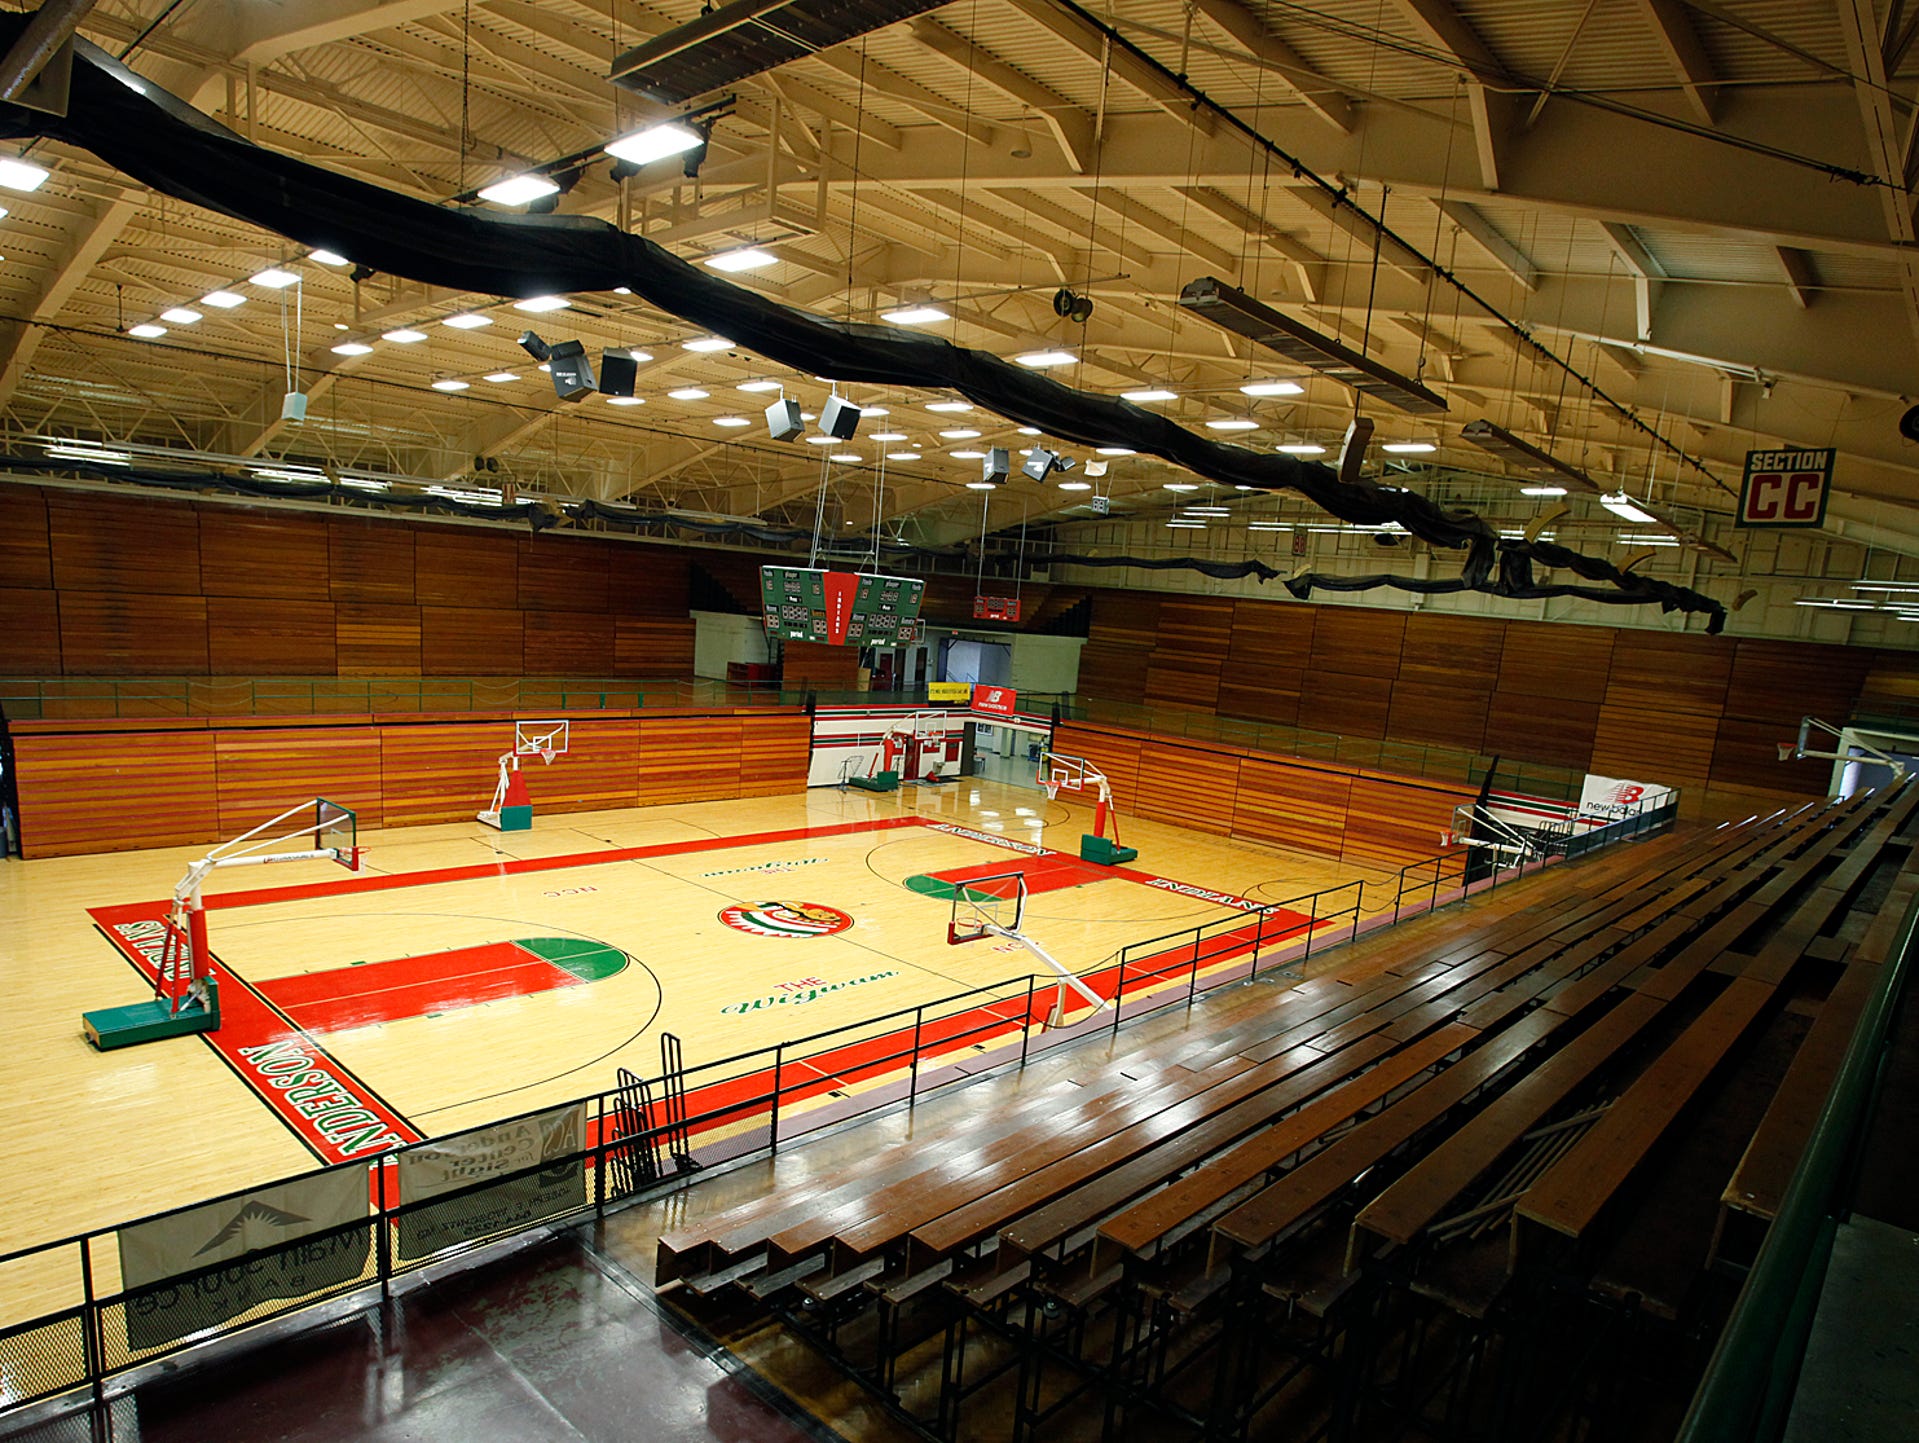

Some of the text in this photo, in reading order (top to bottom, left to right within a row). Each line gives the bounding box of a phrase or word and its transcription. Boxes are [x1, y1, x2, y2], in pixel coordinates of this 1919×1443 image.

[1750, 451, 1828, 471] SECTION
[1747, 473, 1820, 519] CC
[1586, 801, 1611, 811] new
[1145, 878, 1281, 915] INDIANS
[720, 970, 900, 1014] Wigwam
[773, 976, 828, 992] THE
